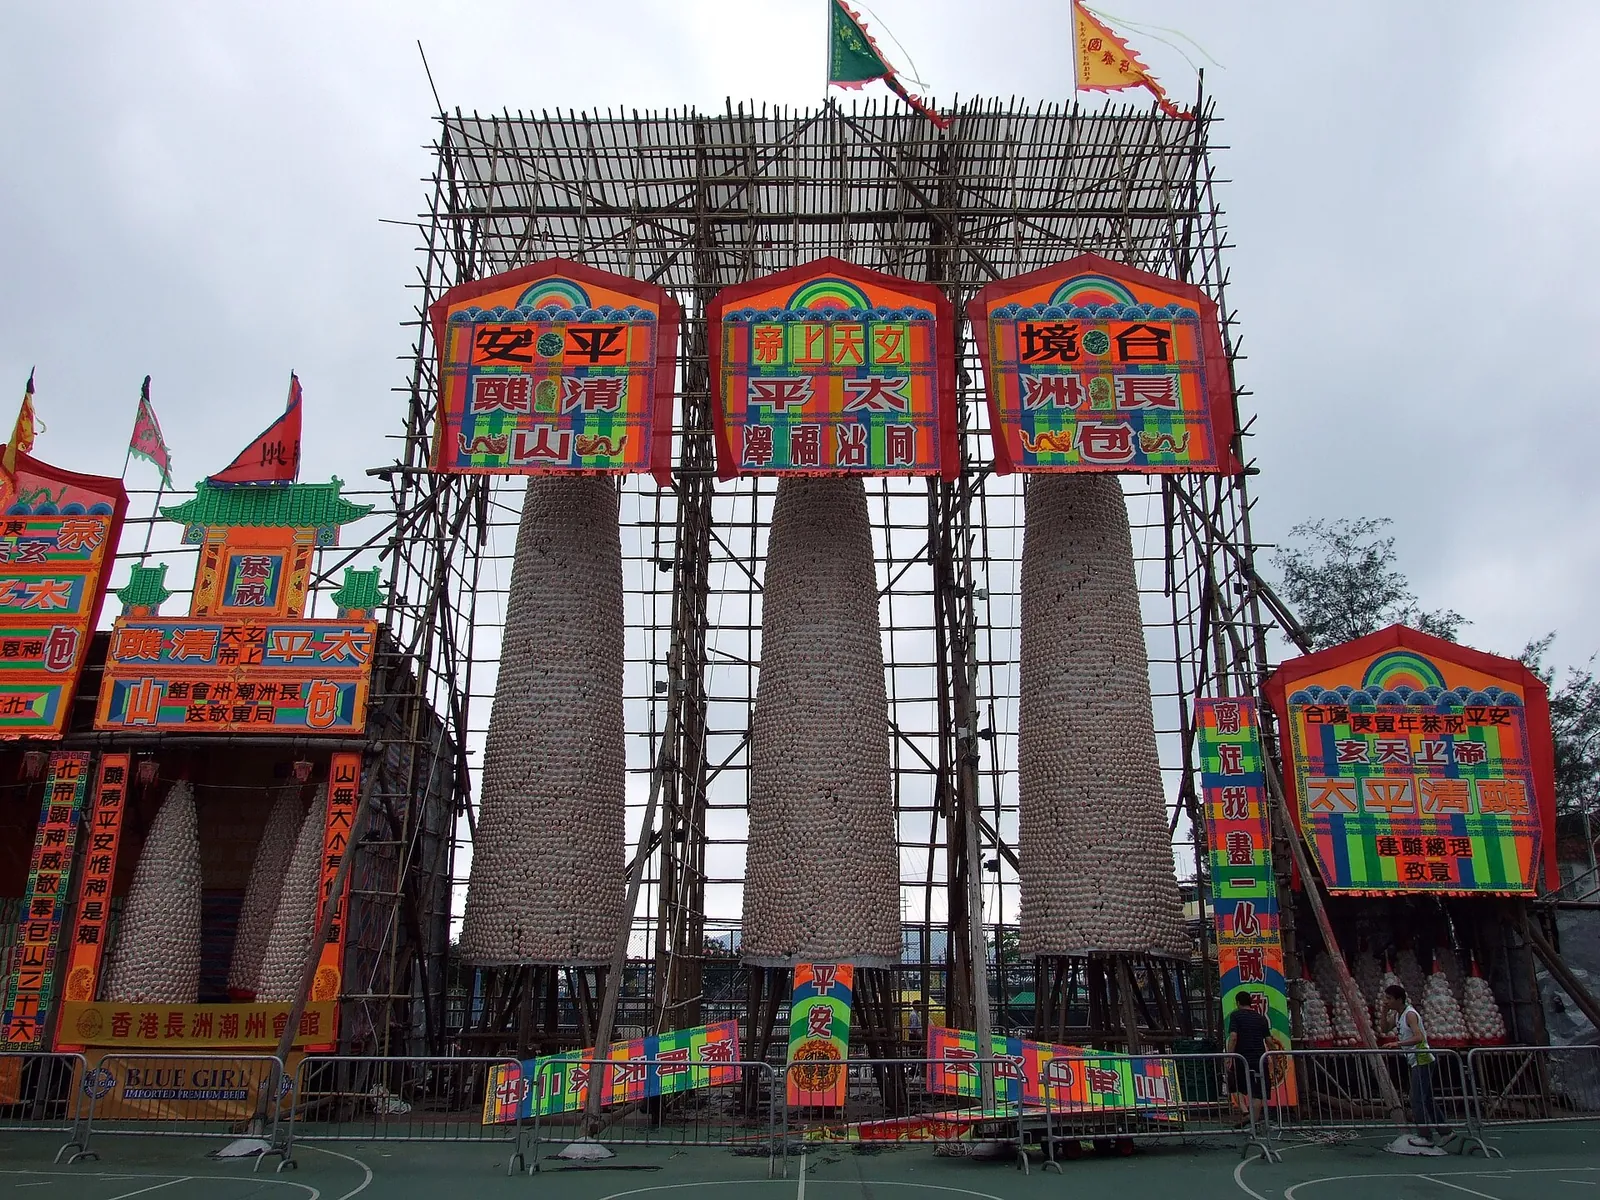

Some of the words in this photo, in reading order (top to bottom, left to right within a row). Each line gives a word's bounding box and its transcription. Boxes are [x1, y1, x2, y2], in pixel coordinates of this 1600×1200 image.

[476, 326, 627, 363] 平安
[754, 326, 905, 364] 玄天上帝
[470, 375, 628, 414] 清醮
[748, 376, 908, 413] 太平
[1019, 373, 1180, 410] 長洲
[509, 424, 574, 464] 山
[742, 424, 917, 467] 同沾福澤
[1074, 422, 1136, 463] 包
[57, 519, 104, 550] 恭
[233, 556, 271, 606] 恭祝
[44, 624, 79, 672] 包
[115, 627, 219, 661] 清醮
[222, 626, 265, 643] 玄天
[267, 629, 372, 664] 太平
[219, 646, 263, 666] 上帝
[123, 676, 163, 727] 山
[305, 678, 340, 729] 包
[1351, 714, 1467, 734] 庚寅年恭祝
[1466, 706, 1511, 726] 平安
[1335, 739, 1488, 766] 玄天上帝
[1308, 779, 1529, 814] 太平清醮
[1404, 861, 1452, 881] 致意
[808, 963, 838, 1040] 平安
[111, 1011, 321, 1039] 香港長洲潮州會館
[124, 1089, 175, 1100] IMPORTED
[178, 1089, 221, 1100] PREMIUM
[223, 1089, 246, 1100] BEER
[125, 1068, 185, 1088] BLUE
[192, 1069, 252, 1088] GIRL
